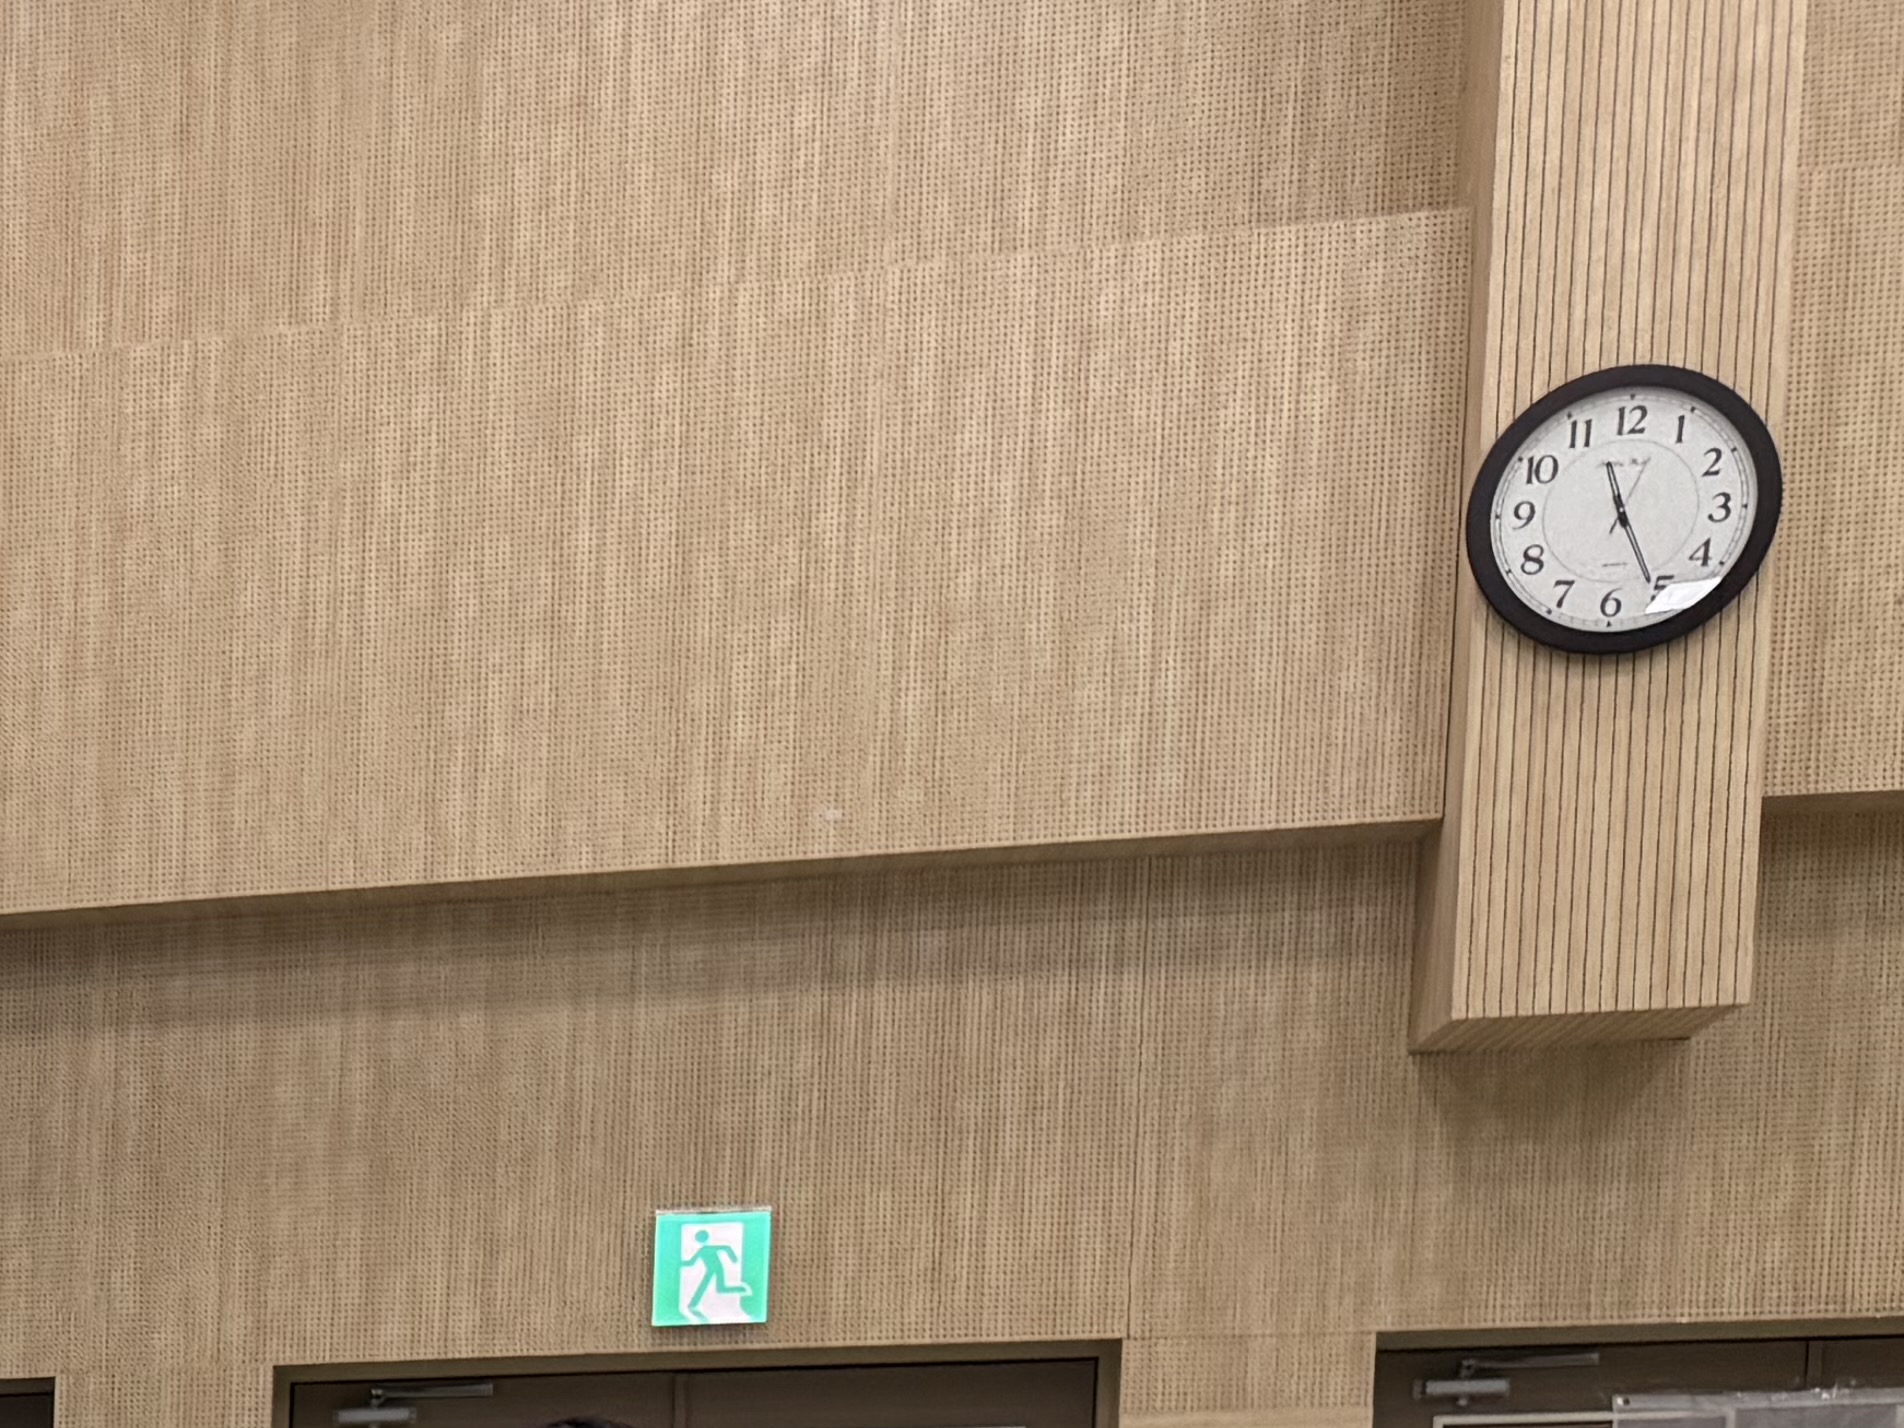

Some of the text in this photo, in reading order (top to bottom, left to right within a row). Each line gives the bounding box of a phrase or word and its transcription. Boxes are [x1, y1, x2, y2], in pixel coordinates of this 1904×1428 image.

[1568, 418, 1593, 449] 11
[1616, 405, 1648, 436] 12
[1675, 414, 1686, 444] 1
[1525, 455, 1559, 485] 10
[1701, 447, 1723, 477] 2
[1512, 500, 1536, 530] 9
[1707, 492, 1732, 523] 3
[1520, 544, 1545, 575] 8
[1688, 537, 1713, 567] 4
[1553, 579, 1576, 608] 7
[1599, 587, 1623, 618] 6
